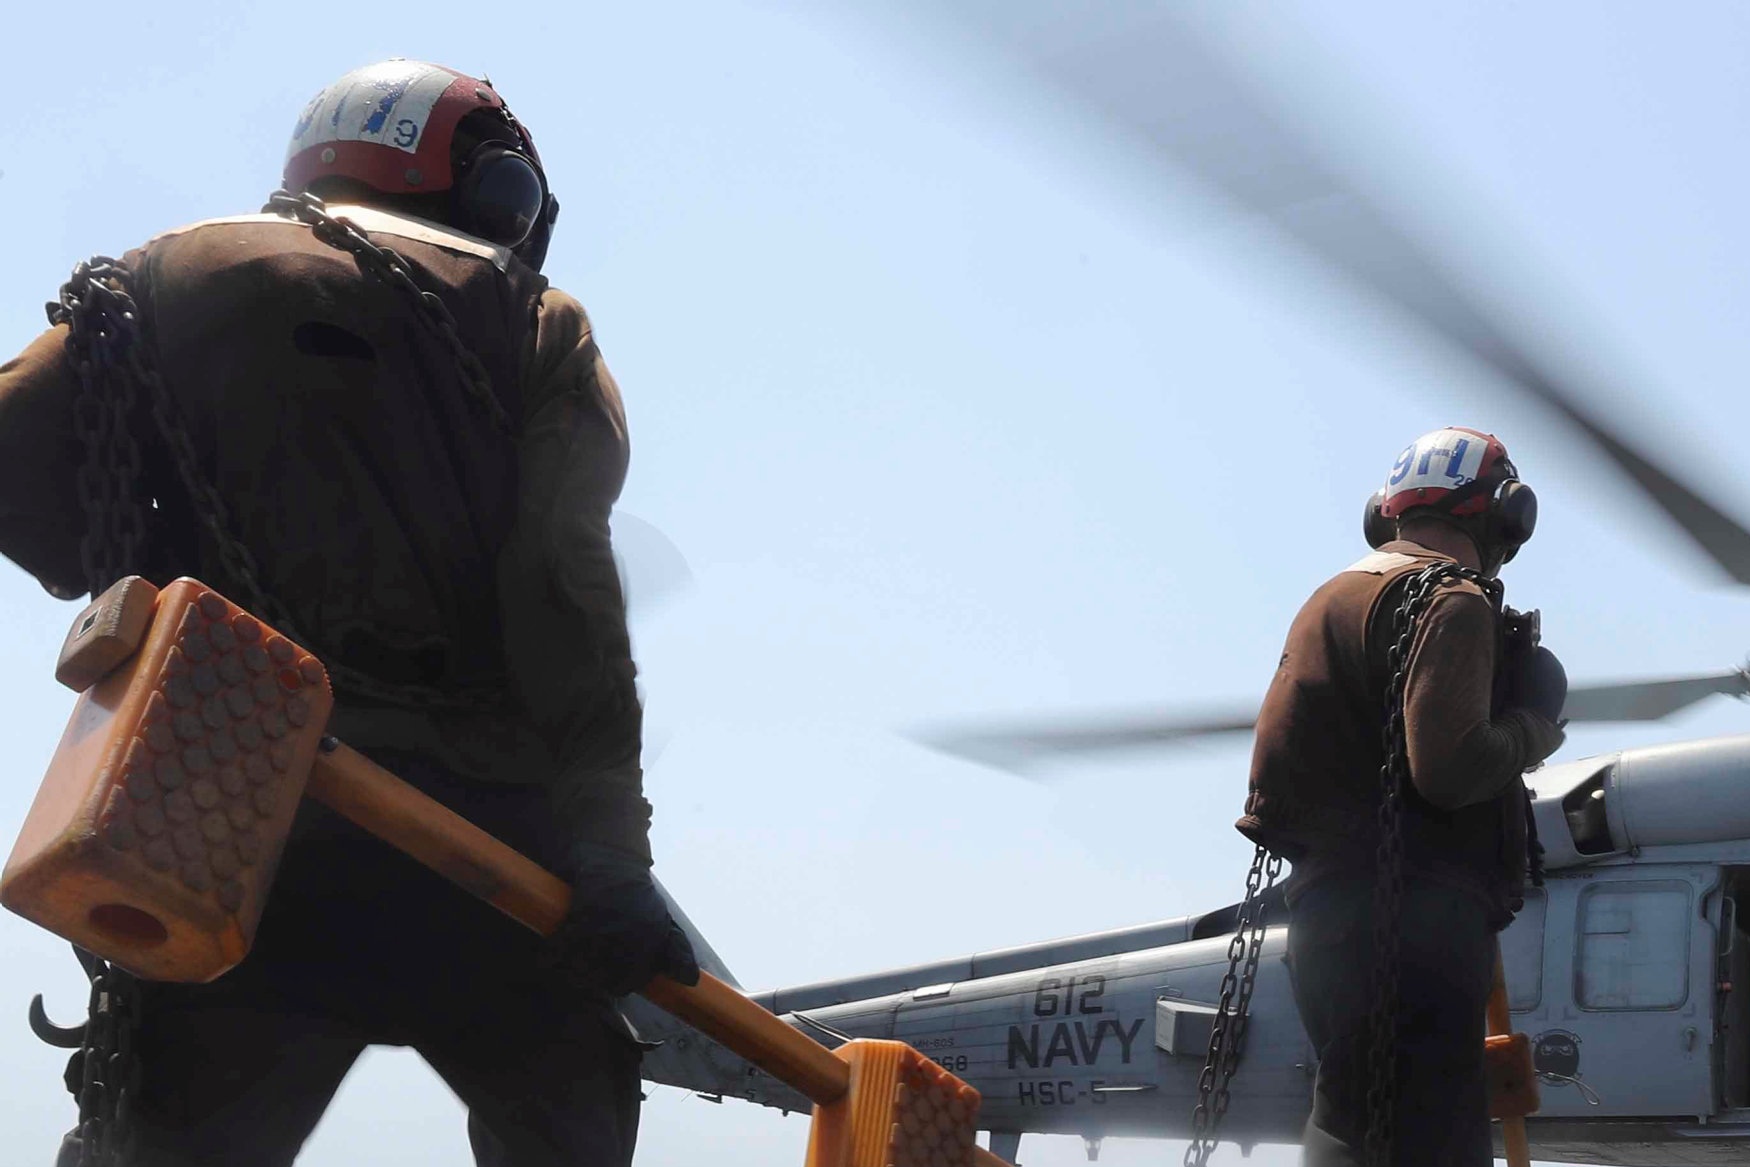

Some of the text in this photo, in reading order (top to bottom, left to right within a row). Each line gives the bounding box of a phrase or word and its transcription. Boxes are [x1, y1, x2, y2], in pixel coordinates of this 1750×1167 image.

[1034, 974, 1106, 1017] 612
[1008, 1018, 1146, 1070] NAVY
[1018, 1080, 1107, 1106] HSC-5
